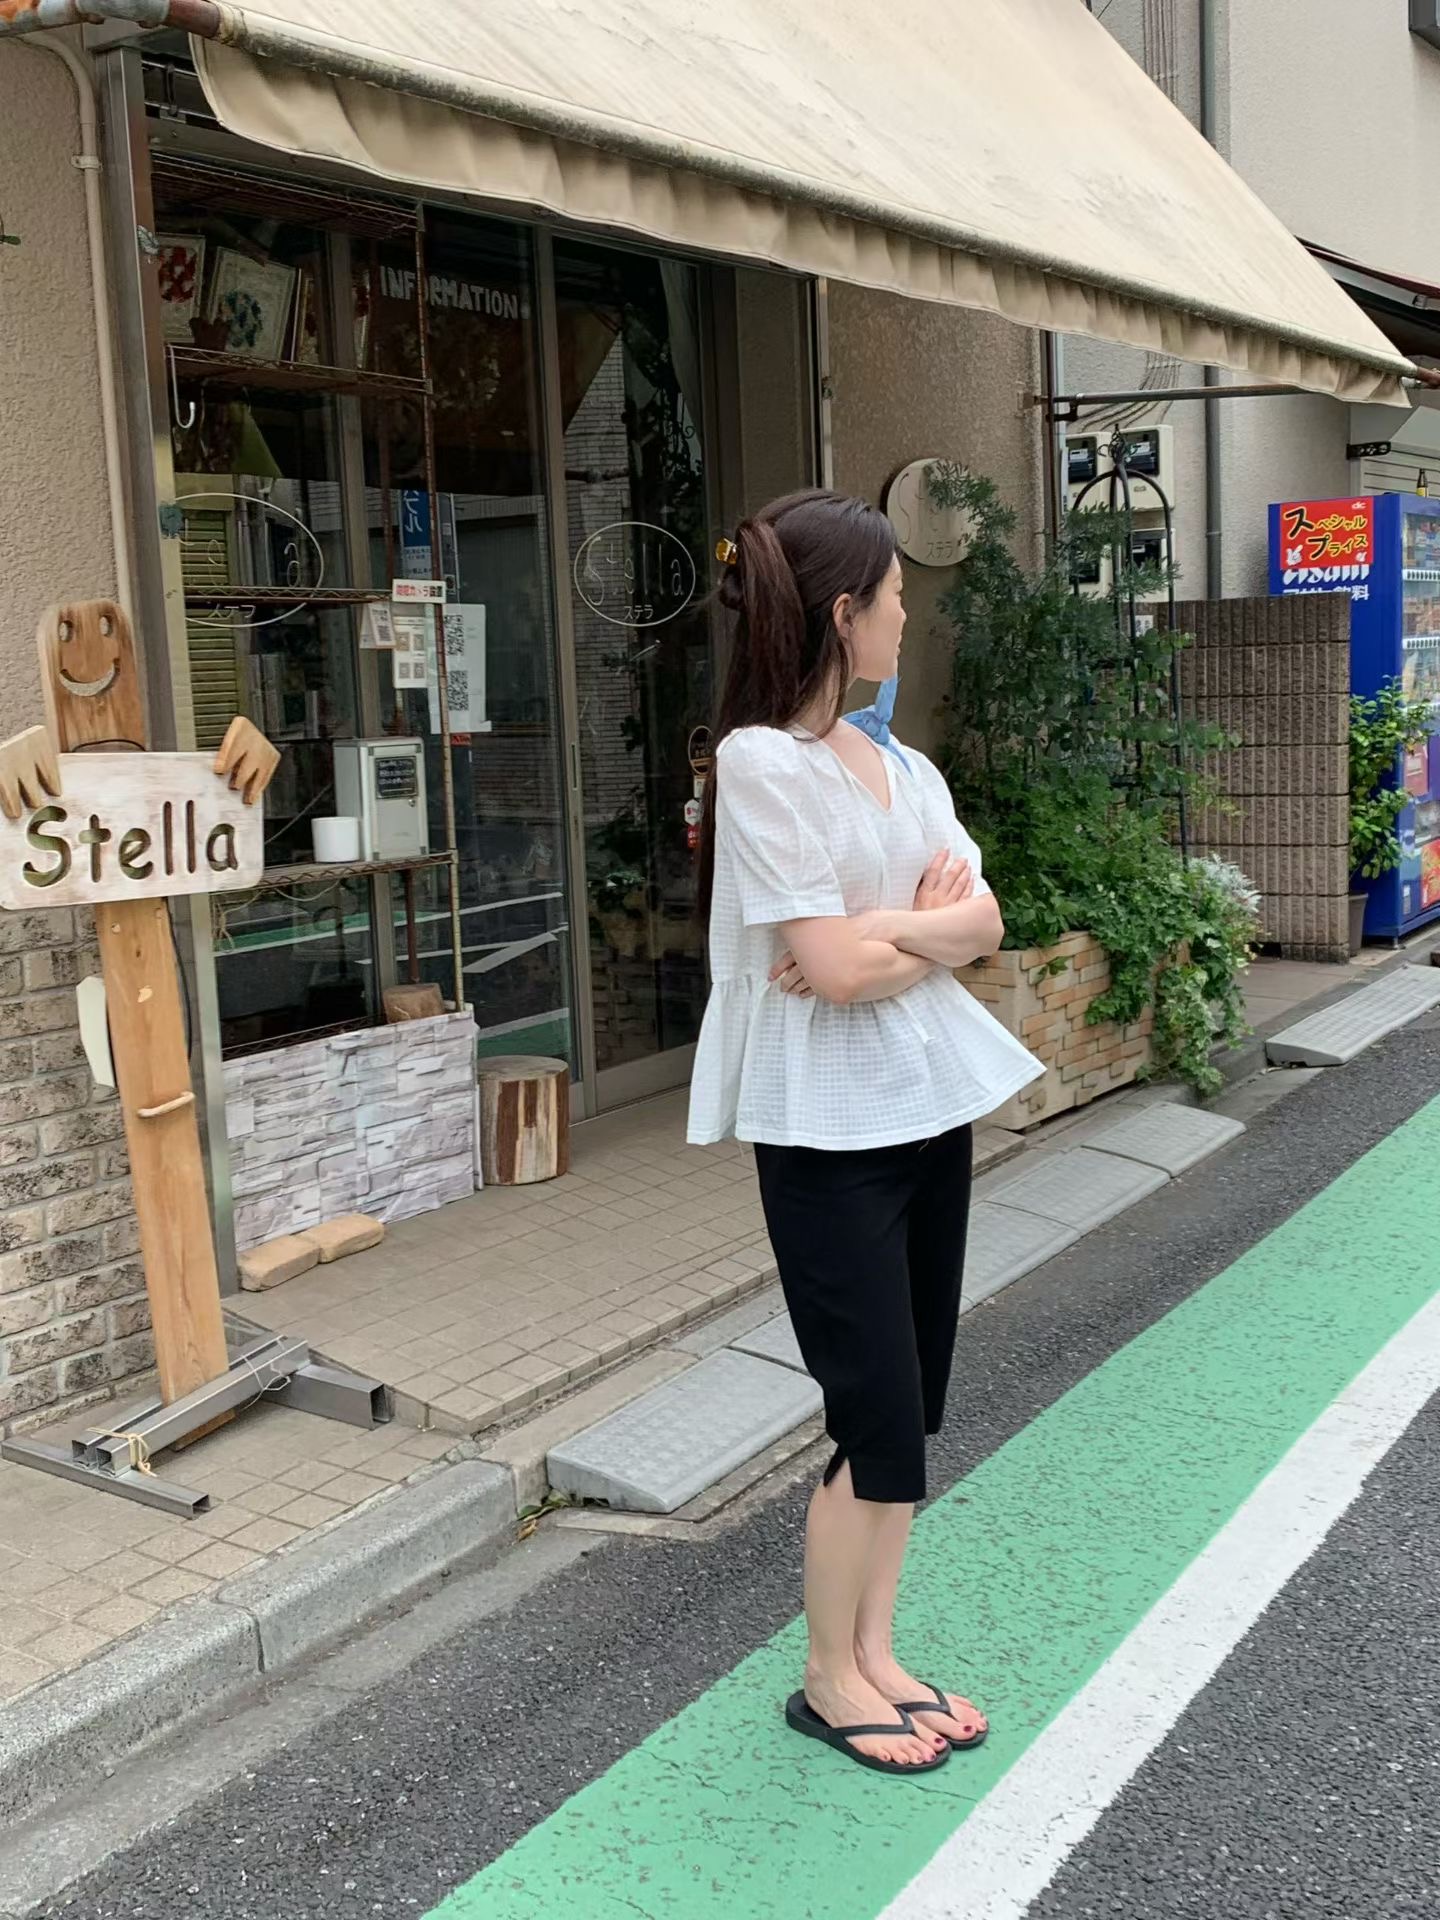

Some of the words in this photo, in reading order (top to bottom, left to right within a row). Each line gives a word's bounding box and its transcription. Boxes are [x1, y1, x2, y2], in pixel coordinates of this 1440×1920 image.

[1284, 506, 1368, 539] スペシャル
[1306, 533, 1368, 561] プライス
[587, 536, 685, 606] Stella
[624, 604, 654, 620] ステラ
[22, 800, 238, 888] Stella
